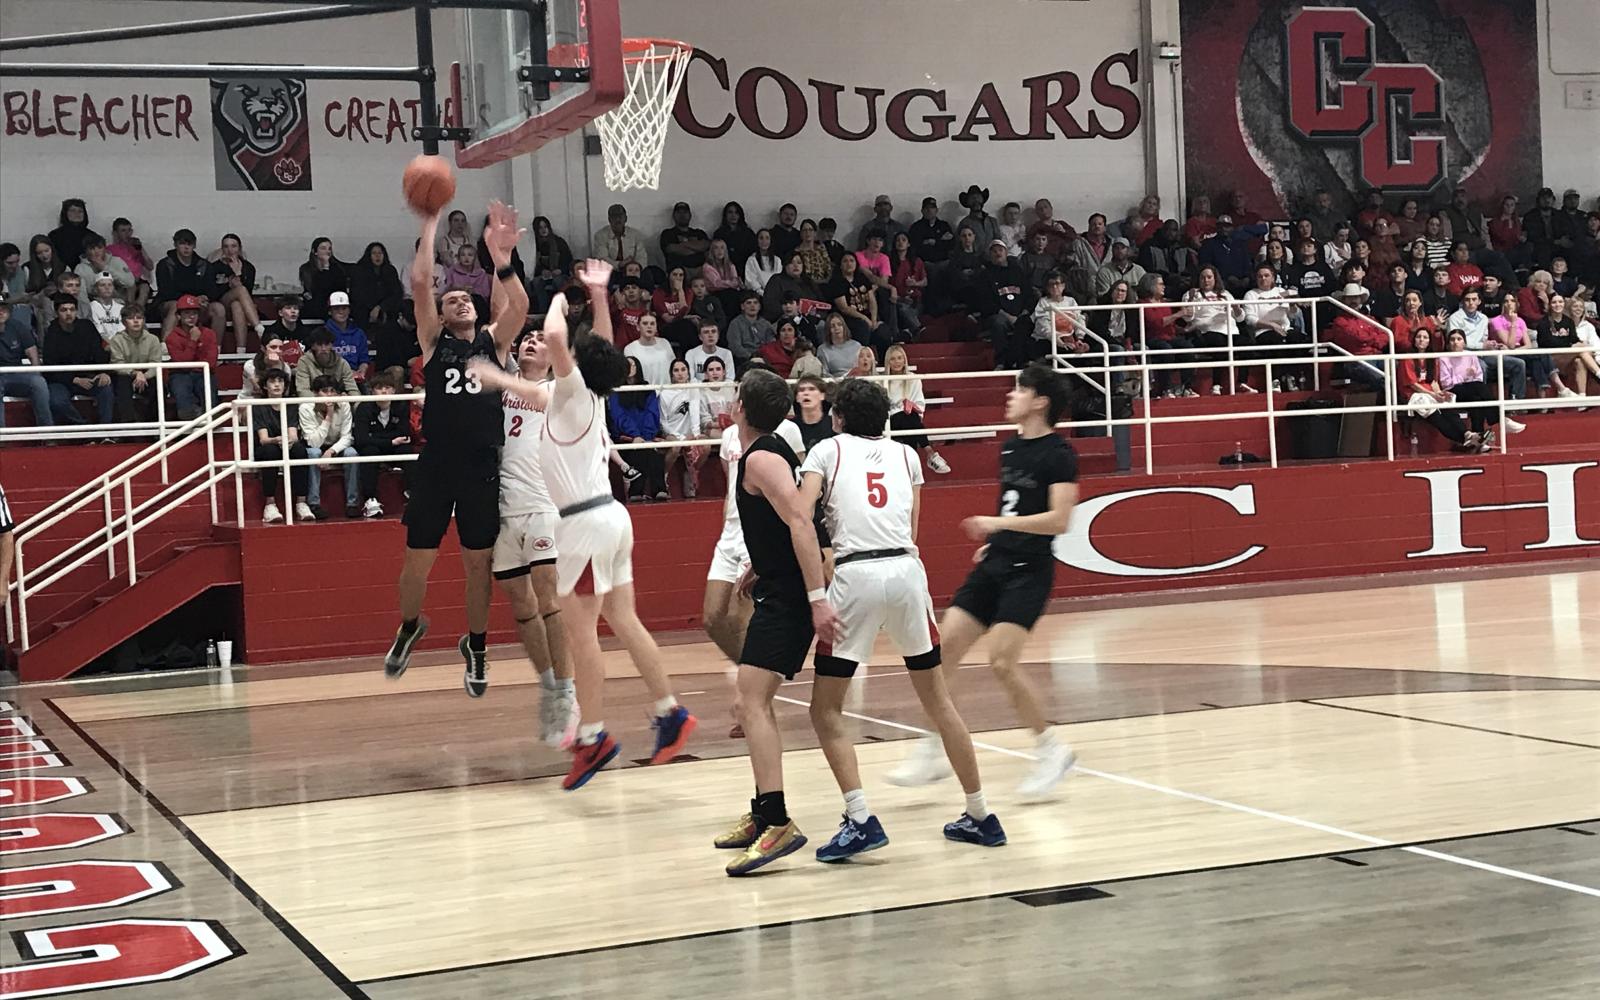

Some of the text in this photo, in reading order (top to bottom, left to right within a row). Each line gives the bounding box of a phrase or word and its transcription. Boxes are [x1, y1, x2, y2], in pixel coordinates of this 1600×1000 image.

[672, 48, 1141, 143] COUGARS
[3, 89, 199, 142] BLEACHER
[444, 368, 482, 395] 23
[508, 415, 523, 437] 2
[866, 472, 889, 509] 5
[1001, 489, 1020, 516] 2
